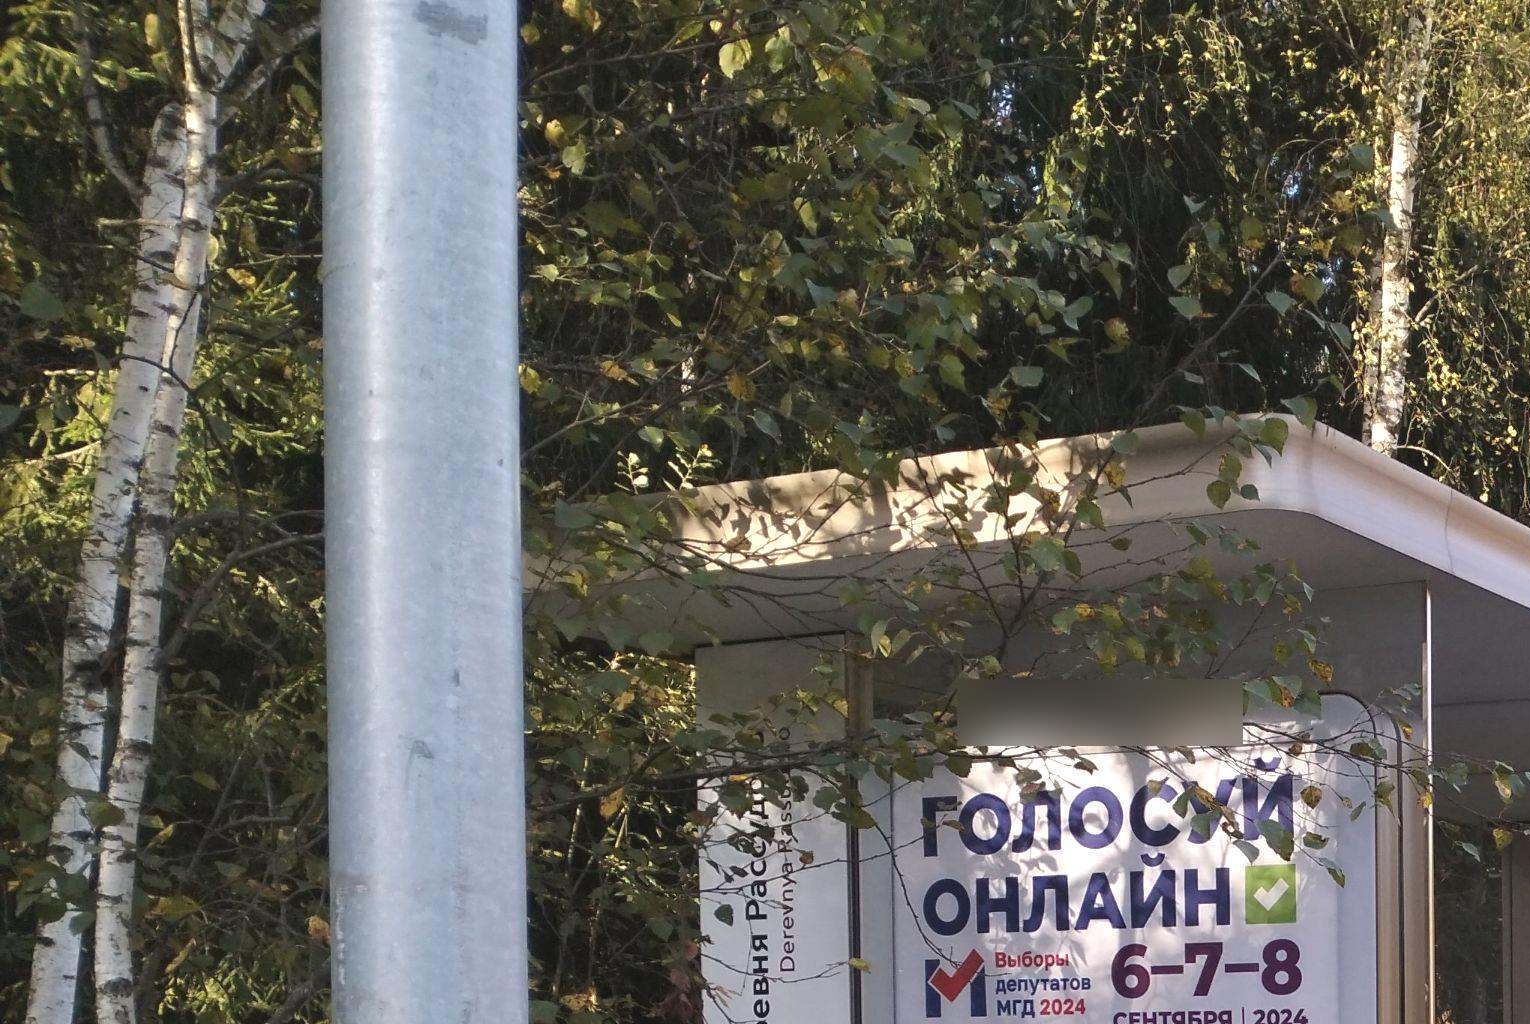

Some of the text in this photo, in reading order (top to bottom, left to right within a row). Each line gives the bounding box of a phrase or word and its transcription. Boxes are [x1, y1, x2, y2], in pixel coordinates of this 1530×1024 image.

[922, 757, 1296, 858] ГОЛОСУЙ
[779, 861, 796, 973] Derevnya
[922, 852, 1232, 936] ОНЛАЙН
[994, 951, 1070, 971] Выборы
[995, 974, 1092, 997] депутатов
[996, 997, 1087, 1020] МГД 2024
